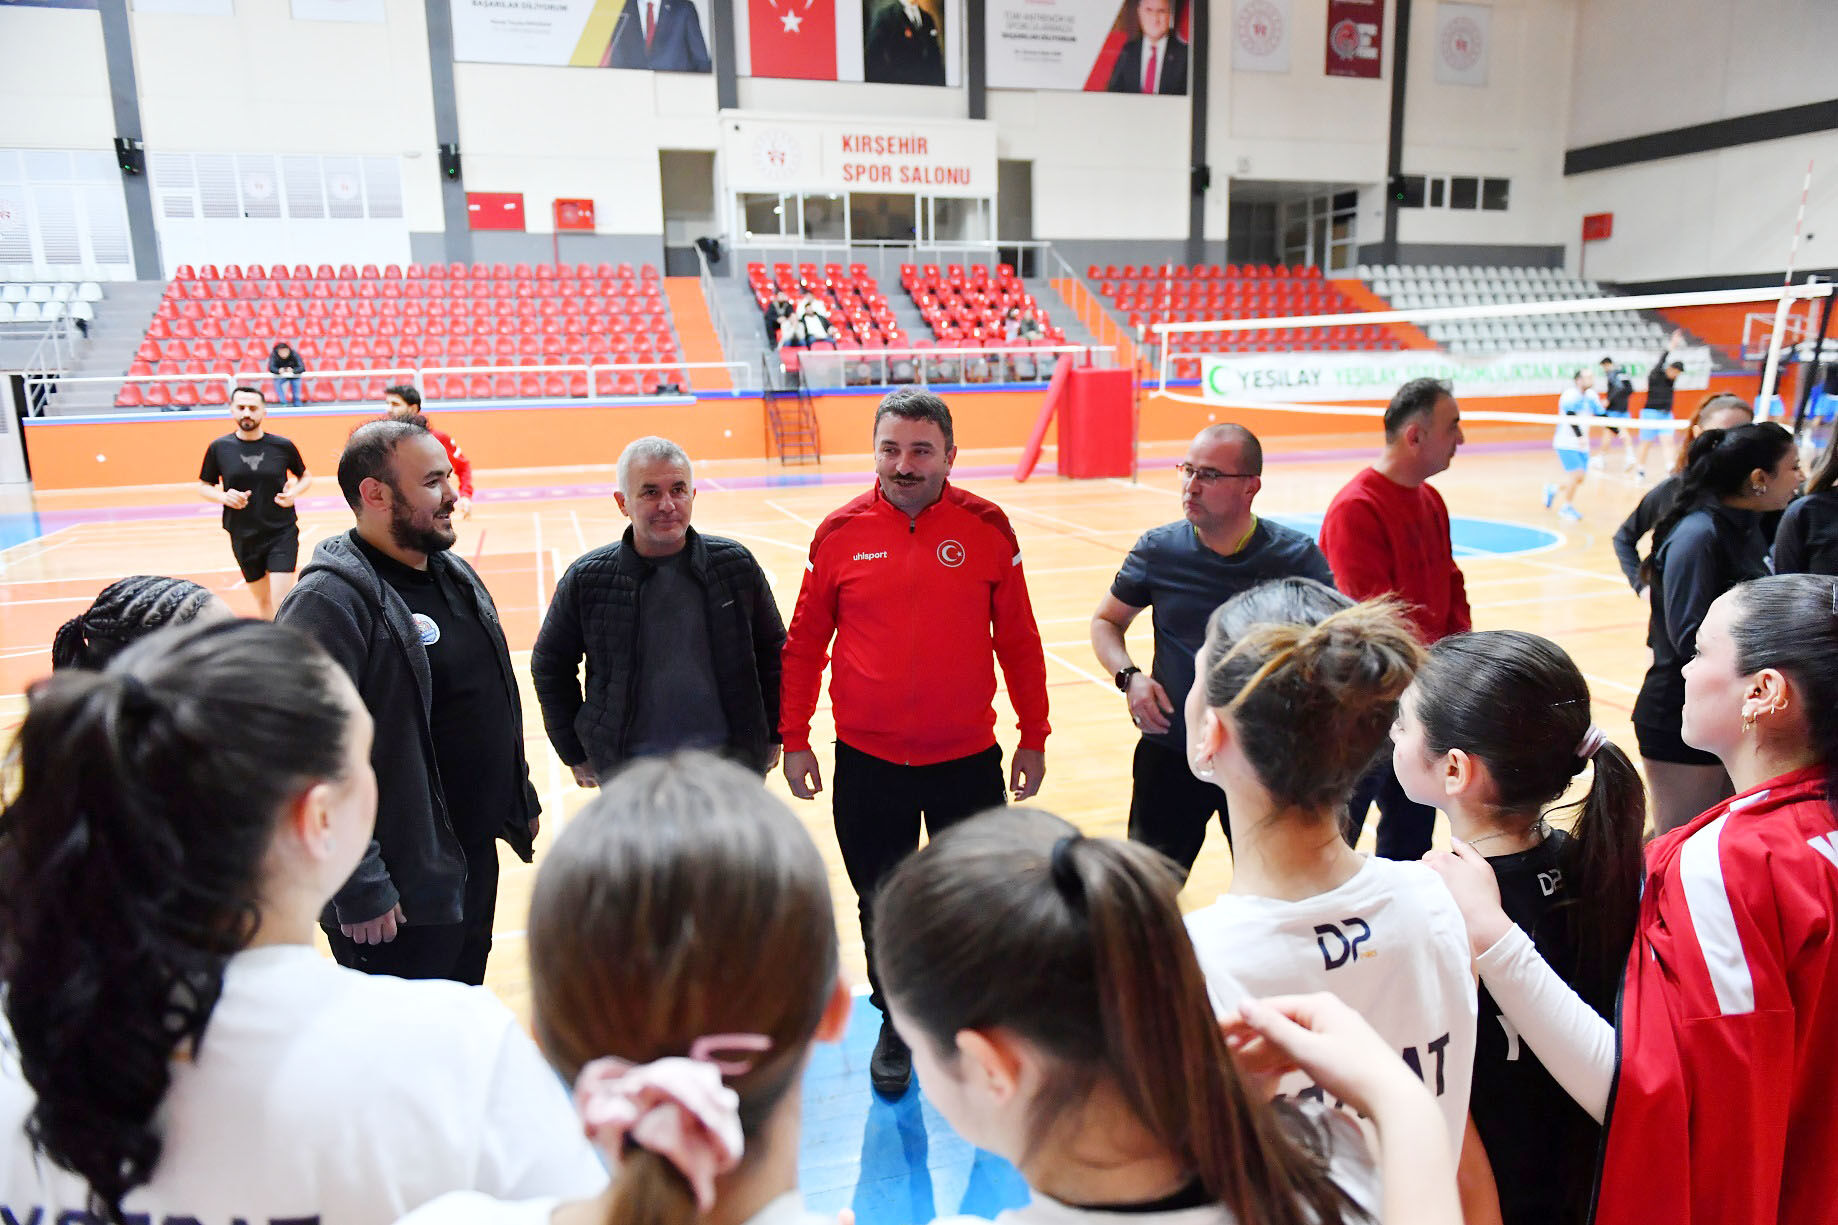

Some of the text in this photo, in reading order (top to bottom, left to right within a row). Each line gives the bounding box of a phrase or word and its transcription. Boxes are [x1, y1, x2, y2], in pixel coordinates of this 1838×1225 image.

[842, 132, 928, 156] KIRŞEHİR
[843, 164, 971, 186] SPOR SALONU
[853, 551, 888, 561] uhlsport
